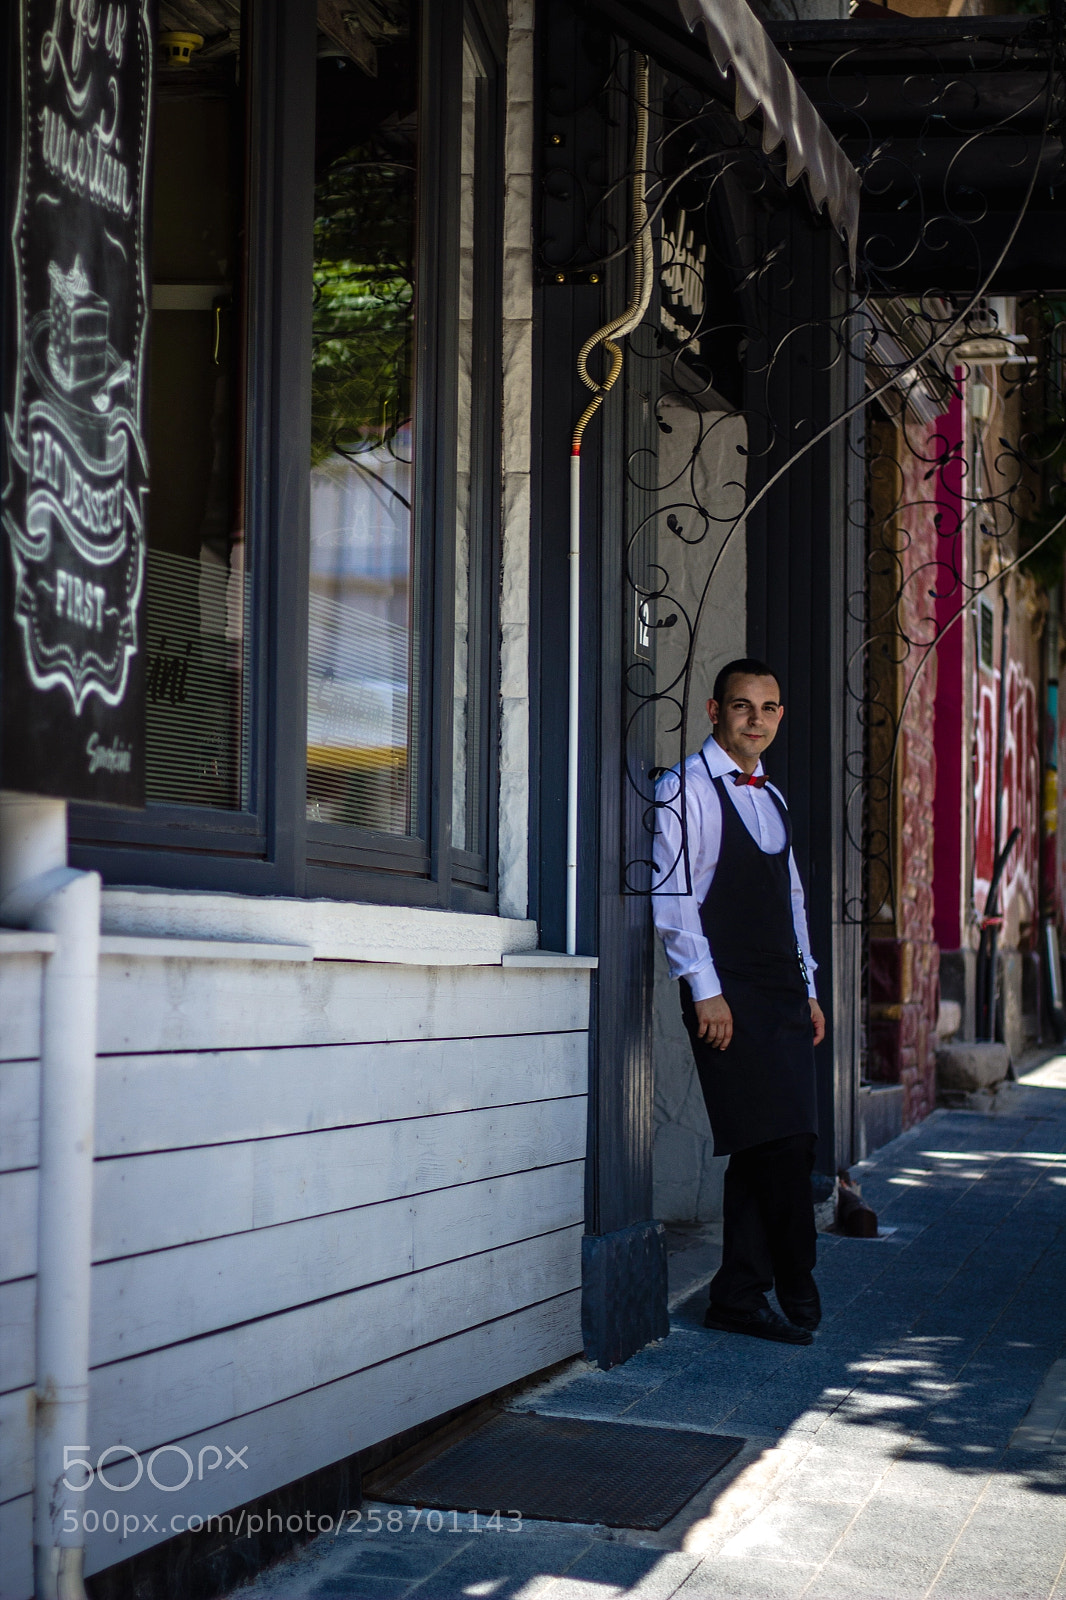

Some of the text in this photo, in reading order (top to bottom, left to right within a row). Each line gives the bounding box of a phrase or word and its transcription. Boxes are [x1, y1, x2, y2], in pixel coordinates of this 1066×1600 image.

[32, 430, 124, 535] EAT DESSERT
[55, 569, 106, 632] FIRST
[638, 600, 649, 648] 12
